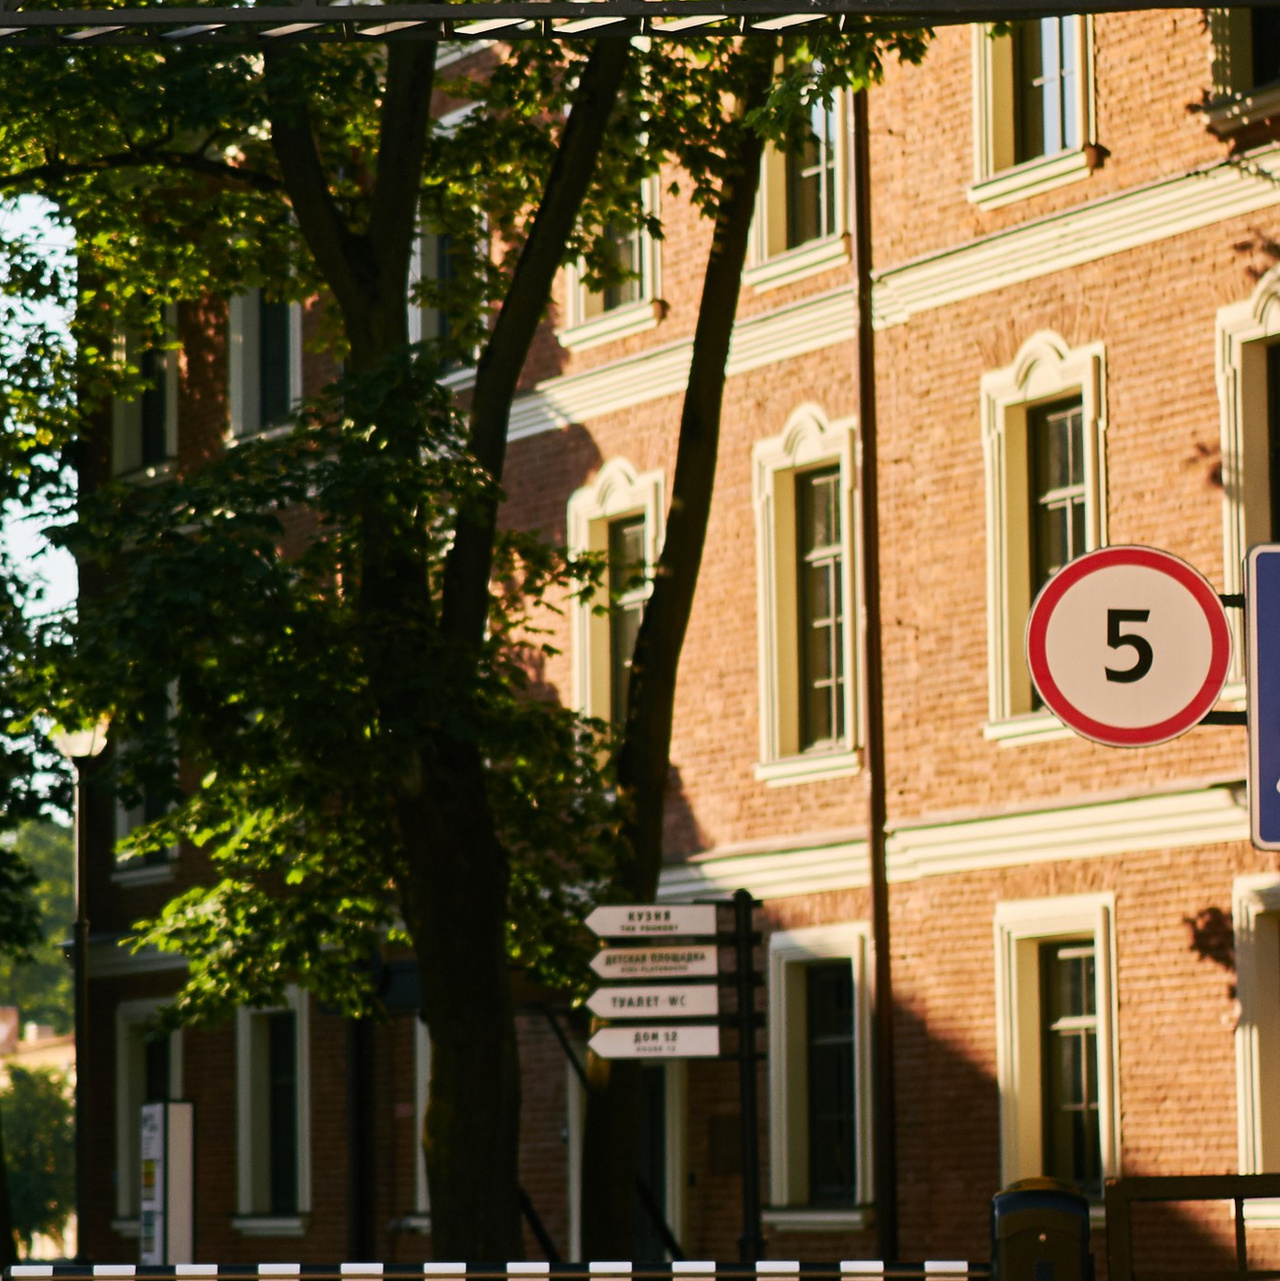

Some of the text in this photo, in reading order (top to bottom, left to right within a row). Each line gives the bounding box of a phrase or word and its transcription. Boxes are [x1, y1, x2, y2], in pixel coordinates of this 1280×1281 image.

[1104, 608, 1154, 684] 5
[628, 910, 671, 921] КУЗНЯ
[605, 952, 705, 966] ДЕТСКАЯ ПЛОЩАДКА
[611, 995, 686, 1008] ТУАЛЕТ WC
[634, 1031, 677, 1044] ДОМ 12
